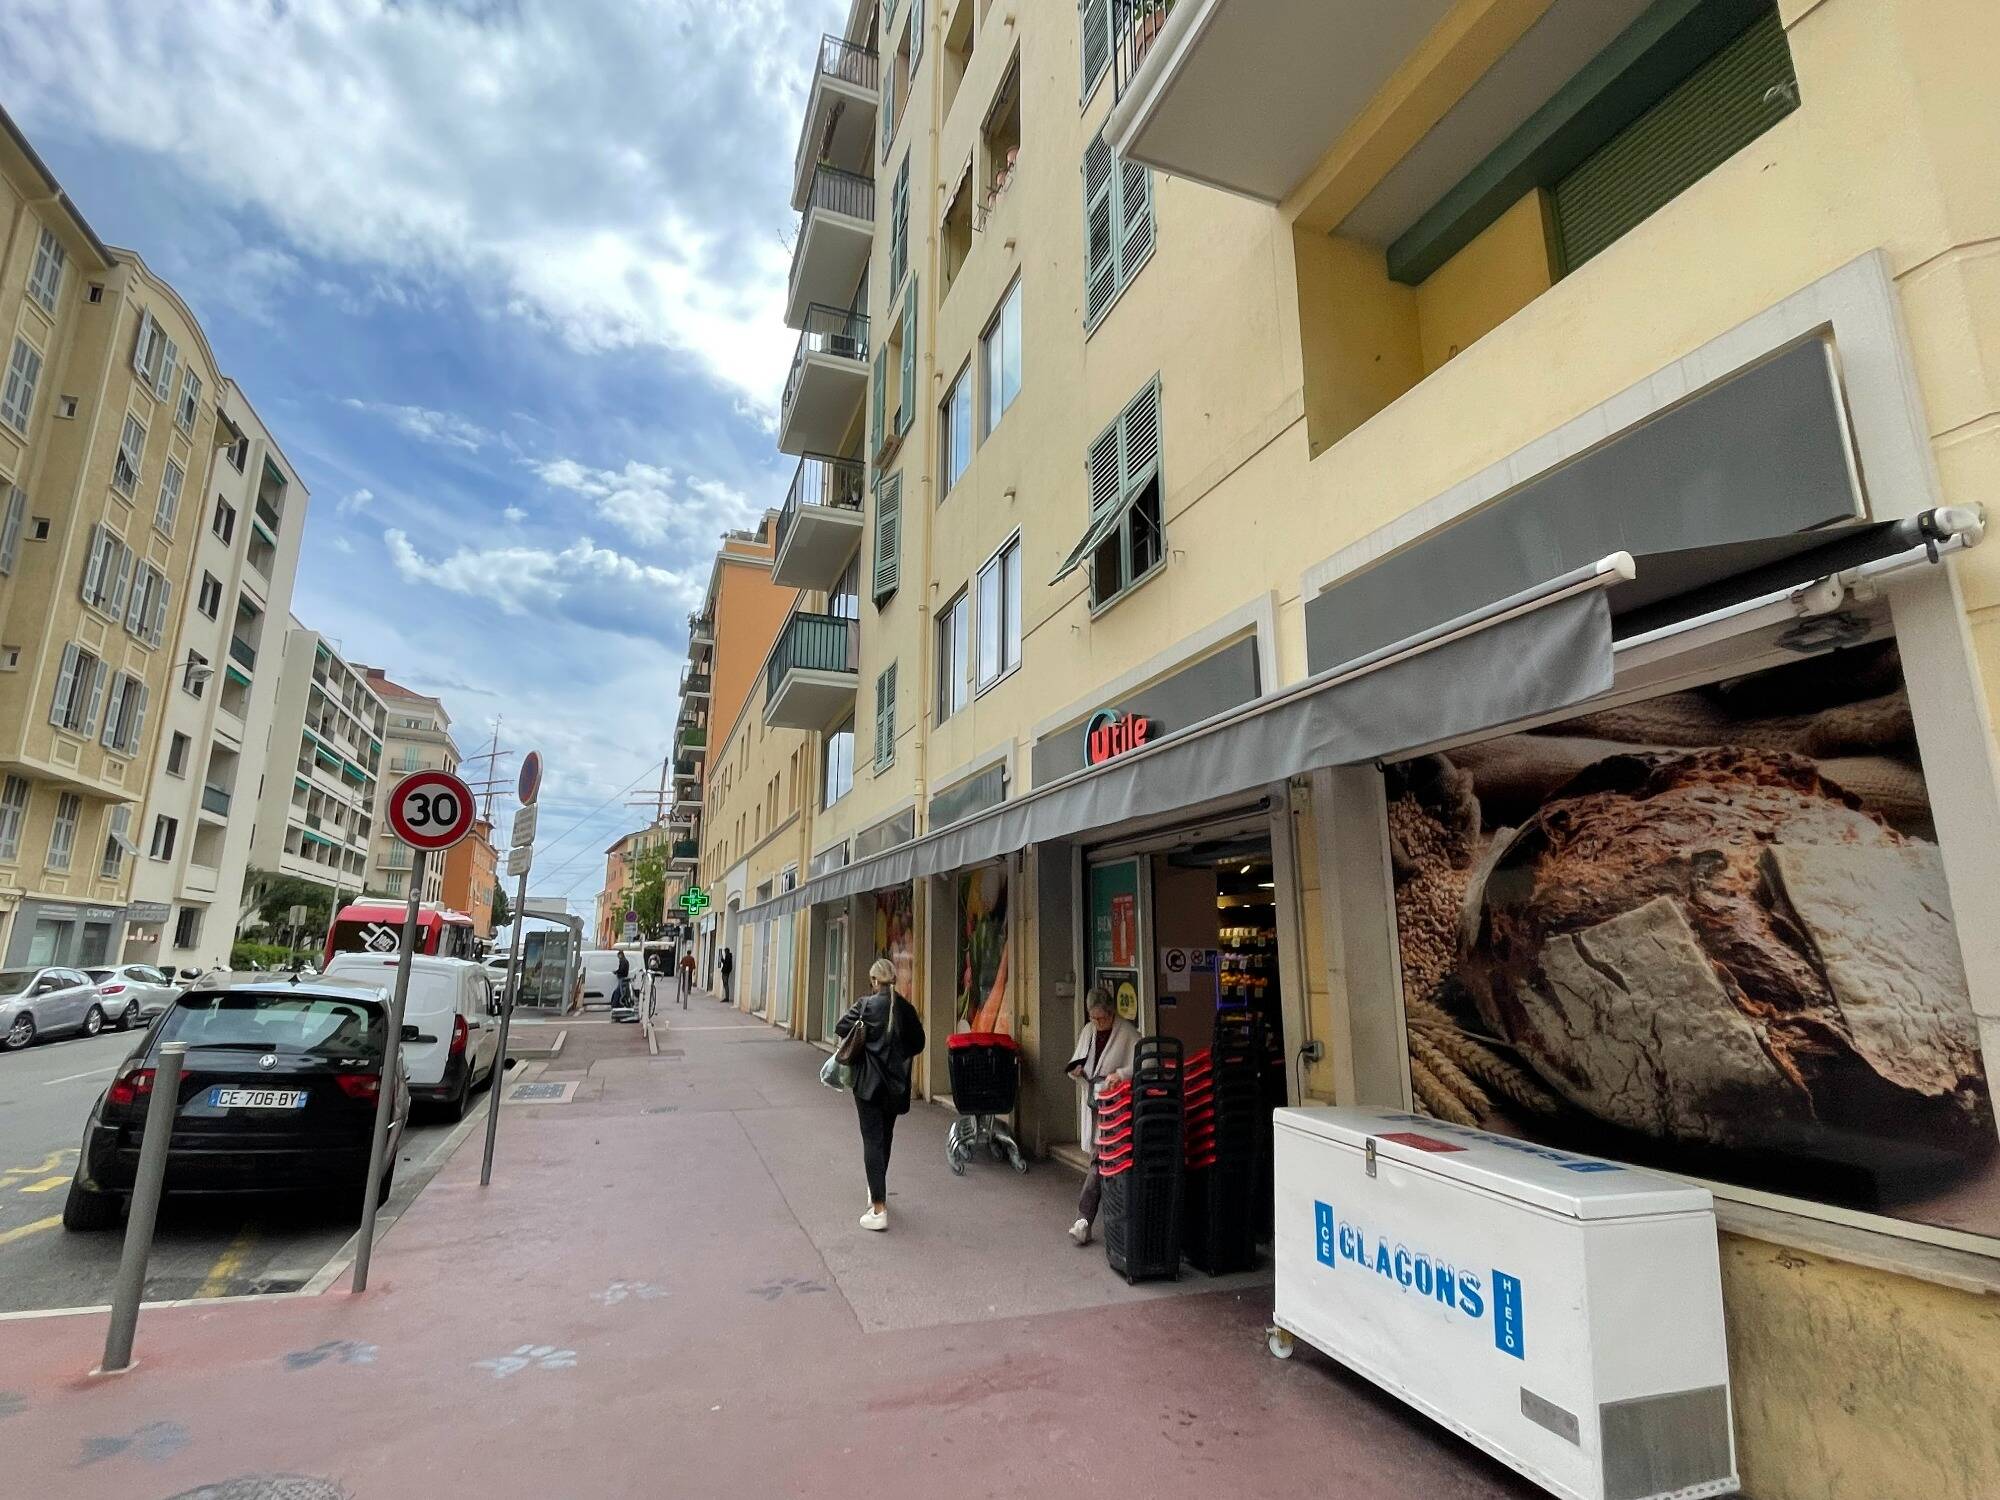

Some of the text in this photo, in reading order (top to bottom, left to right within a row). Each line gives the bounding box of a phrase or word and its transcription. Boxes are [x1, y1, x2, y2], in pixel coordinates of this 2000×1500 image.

[406, 793, 458, 827] 30
[1320, 1210, 1330, 1258] ICE
[1339, 1220, 1485, 1318] GLAÇONS
[1503, 1280, 1515, 1348] HIELO
